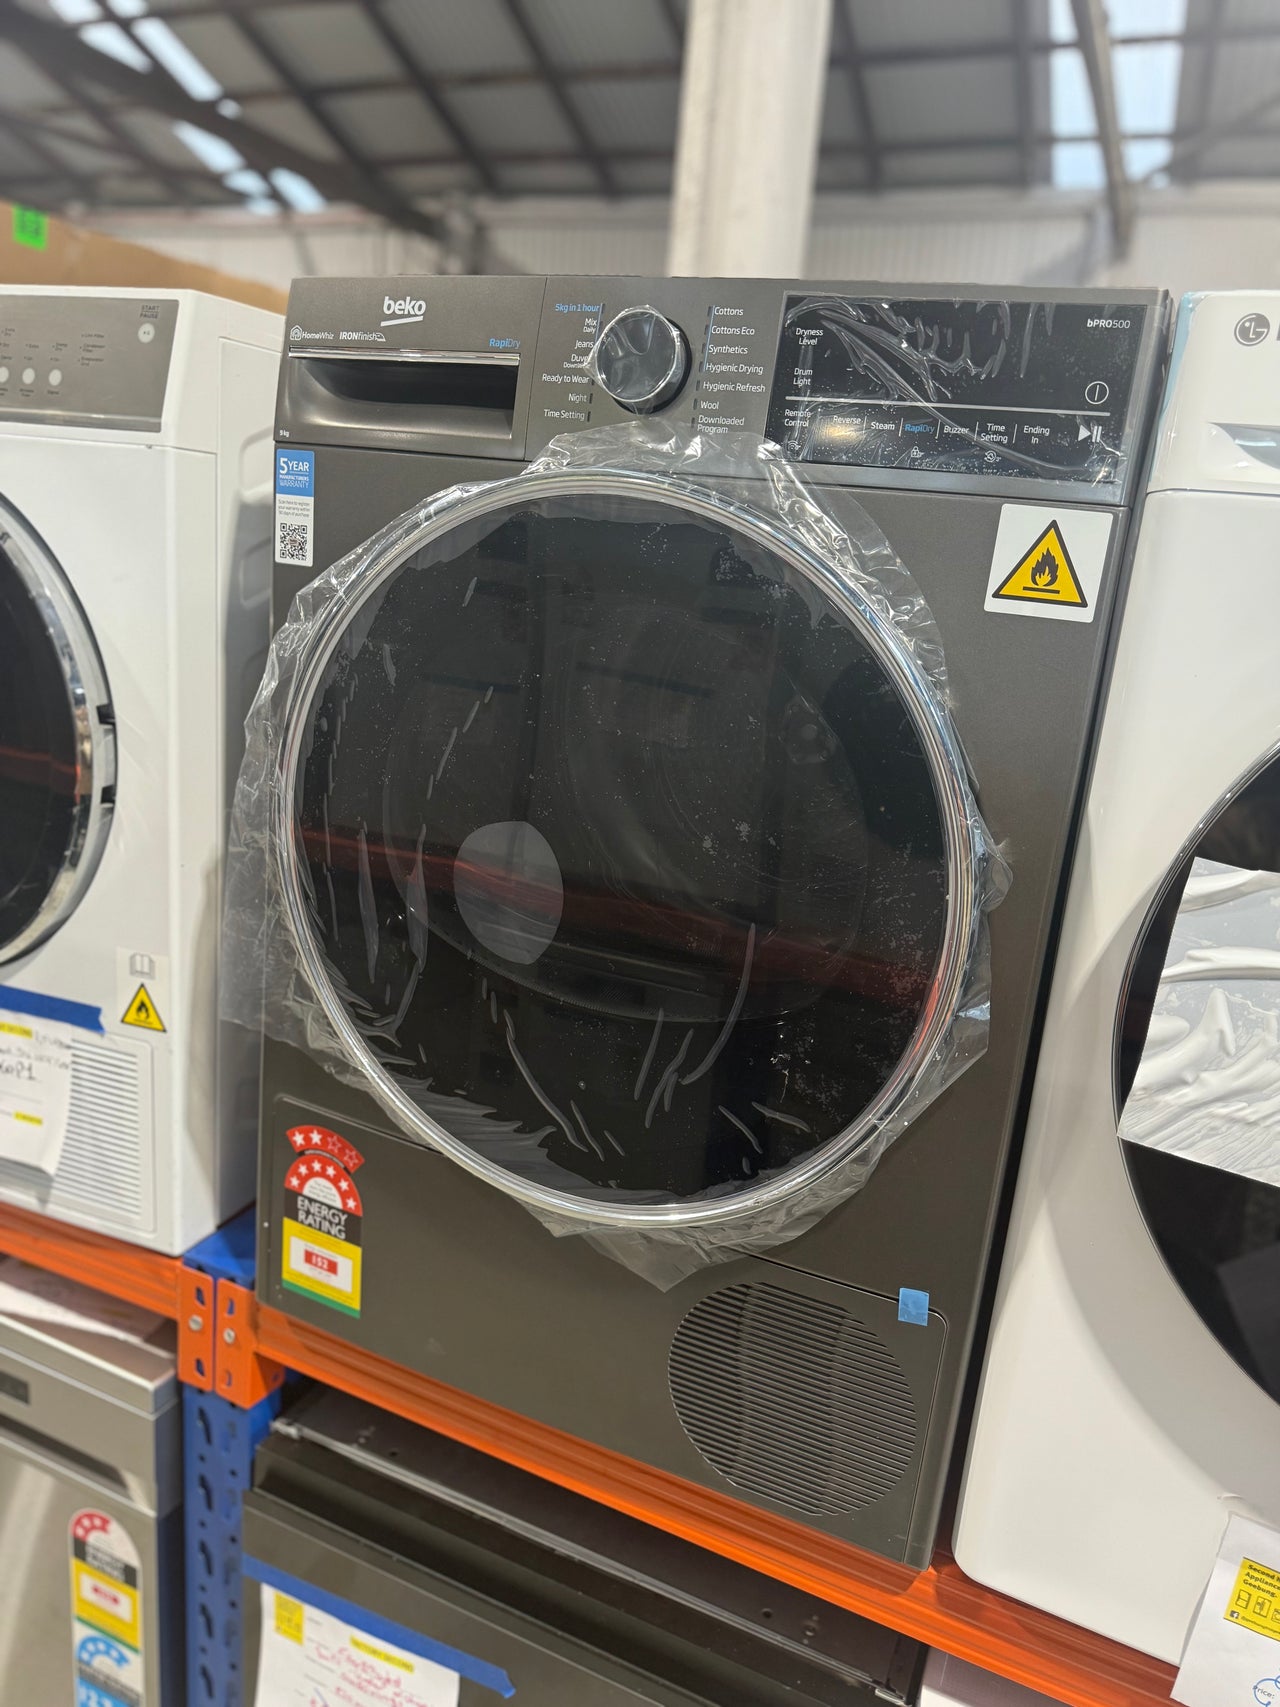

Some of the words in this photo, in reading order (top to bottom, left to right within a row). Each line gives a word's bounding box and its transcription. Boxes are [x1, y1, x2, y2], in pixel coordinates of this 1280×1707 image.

[383, 296, 426, 315] beko
[555, 303, 569, 313] 5kg
[583, 304, 600, 312] hour
[714, 306, 744, 316] Cottons
[585, 318, 597, 326] Mix
[1087, 318, 1131, 329] bPRO500
[583, 326, 597, 334] Daily
[711, 325, 741, 335] Cottons
[741, 327, 755, 335] Eco
[796, 327, 823, 336] Dryness
[302, 331, 334, 340] HomeWhiz
[339, 331, 378, 341] IRONfinish
[490, 338, 520, 349] RapiDry
[575, 340, 594, 349] Jeans
[798, 337, 818, 345] Level
[708, 344, 748, 355] Synthetics
[706, 362, 738, 374] Hygienic
[738, 364, 763, 375] Drying
[794, 367, 813, 376] Drum
[542, 374, 563, 384] Ready
[564, 375, 571, 383] to
[571, 375, 589, 383] Wear
[793, 377, 811, 388] Light
[703, 381, 735, 392] Hygienic
[736, 383, 766, 393] Refresh
[569, 393, 587, 403] Night
[700, 400, 719, 409] Wool
[544, 409, 560, 418] Time
[560, 410, 585, 421] Setting
[784, 408, 811, 418] Remote
[698, 415, 745, 425] Downloaded
[784, 418, 809, 427] Control
[833, 415, 861, 425] Reverse
[697, 424, 728, 434] Program
[871, 422, 896, 431] Steam
[905, 423, 935, 434] RapiDry
[943, 426, 969, 434] Buzzer
[987, 423, 1005, 432] Time
[1023, 425, 1050, 436] Ending
[980, 432, 1009, 444] Setting
[1031, 436, 1039, 444] In
[280, 457, 288, 474] 5
[288, 461, 310, 472] YEAR
[297, 1196, 348, 1226] ENERGY
[298, 1210, 346, 1240] RATING
[1248, 1564, 1276, 1580] Second
